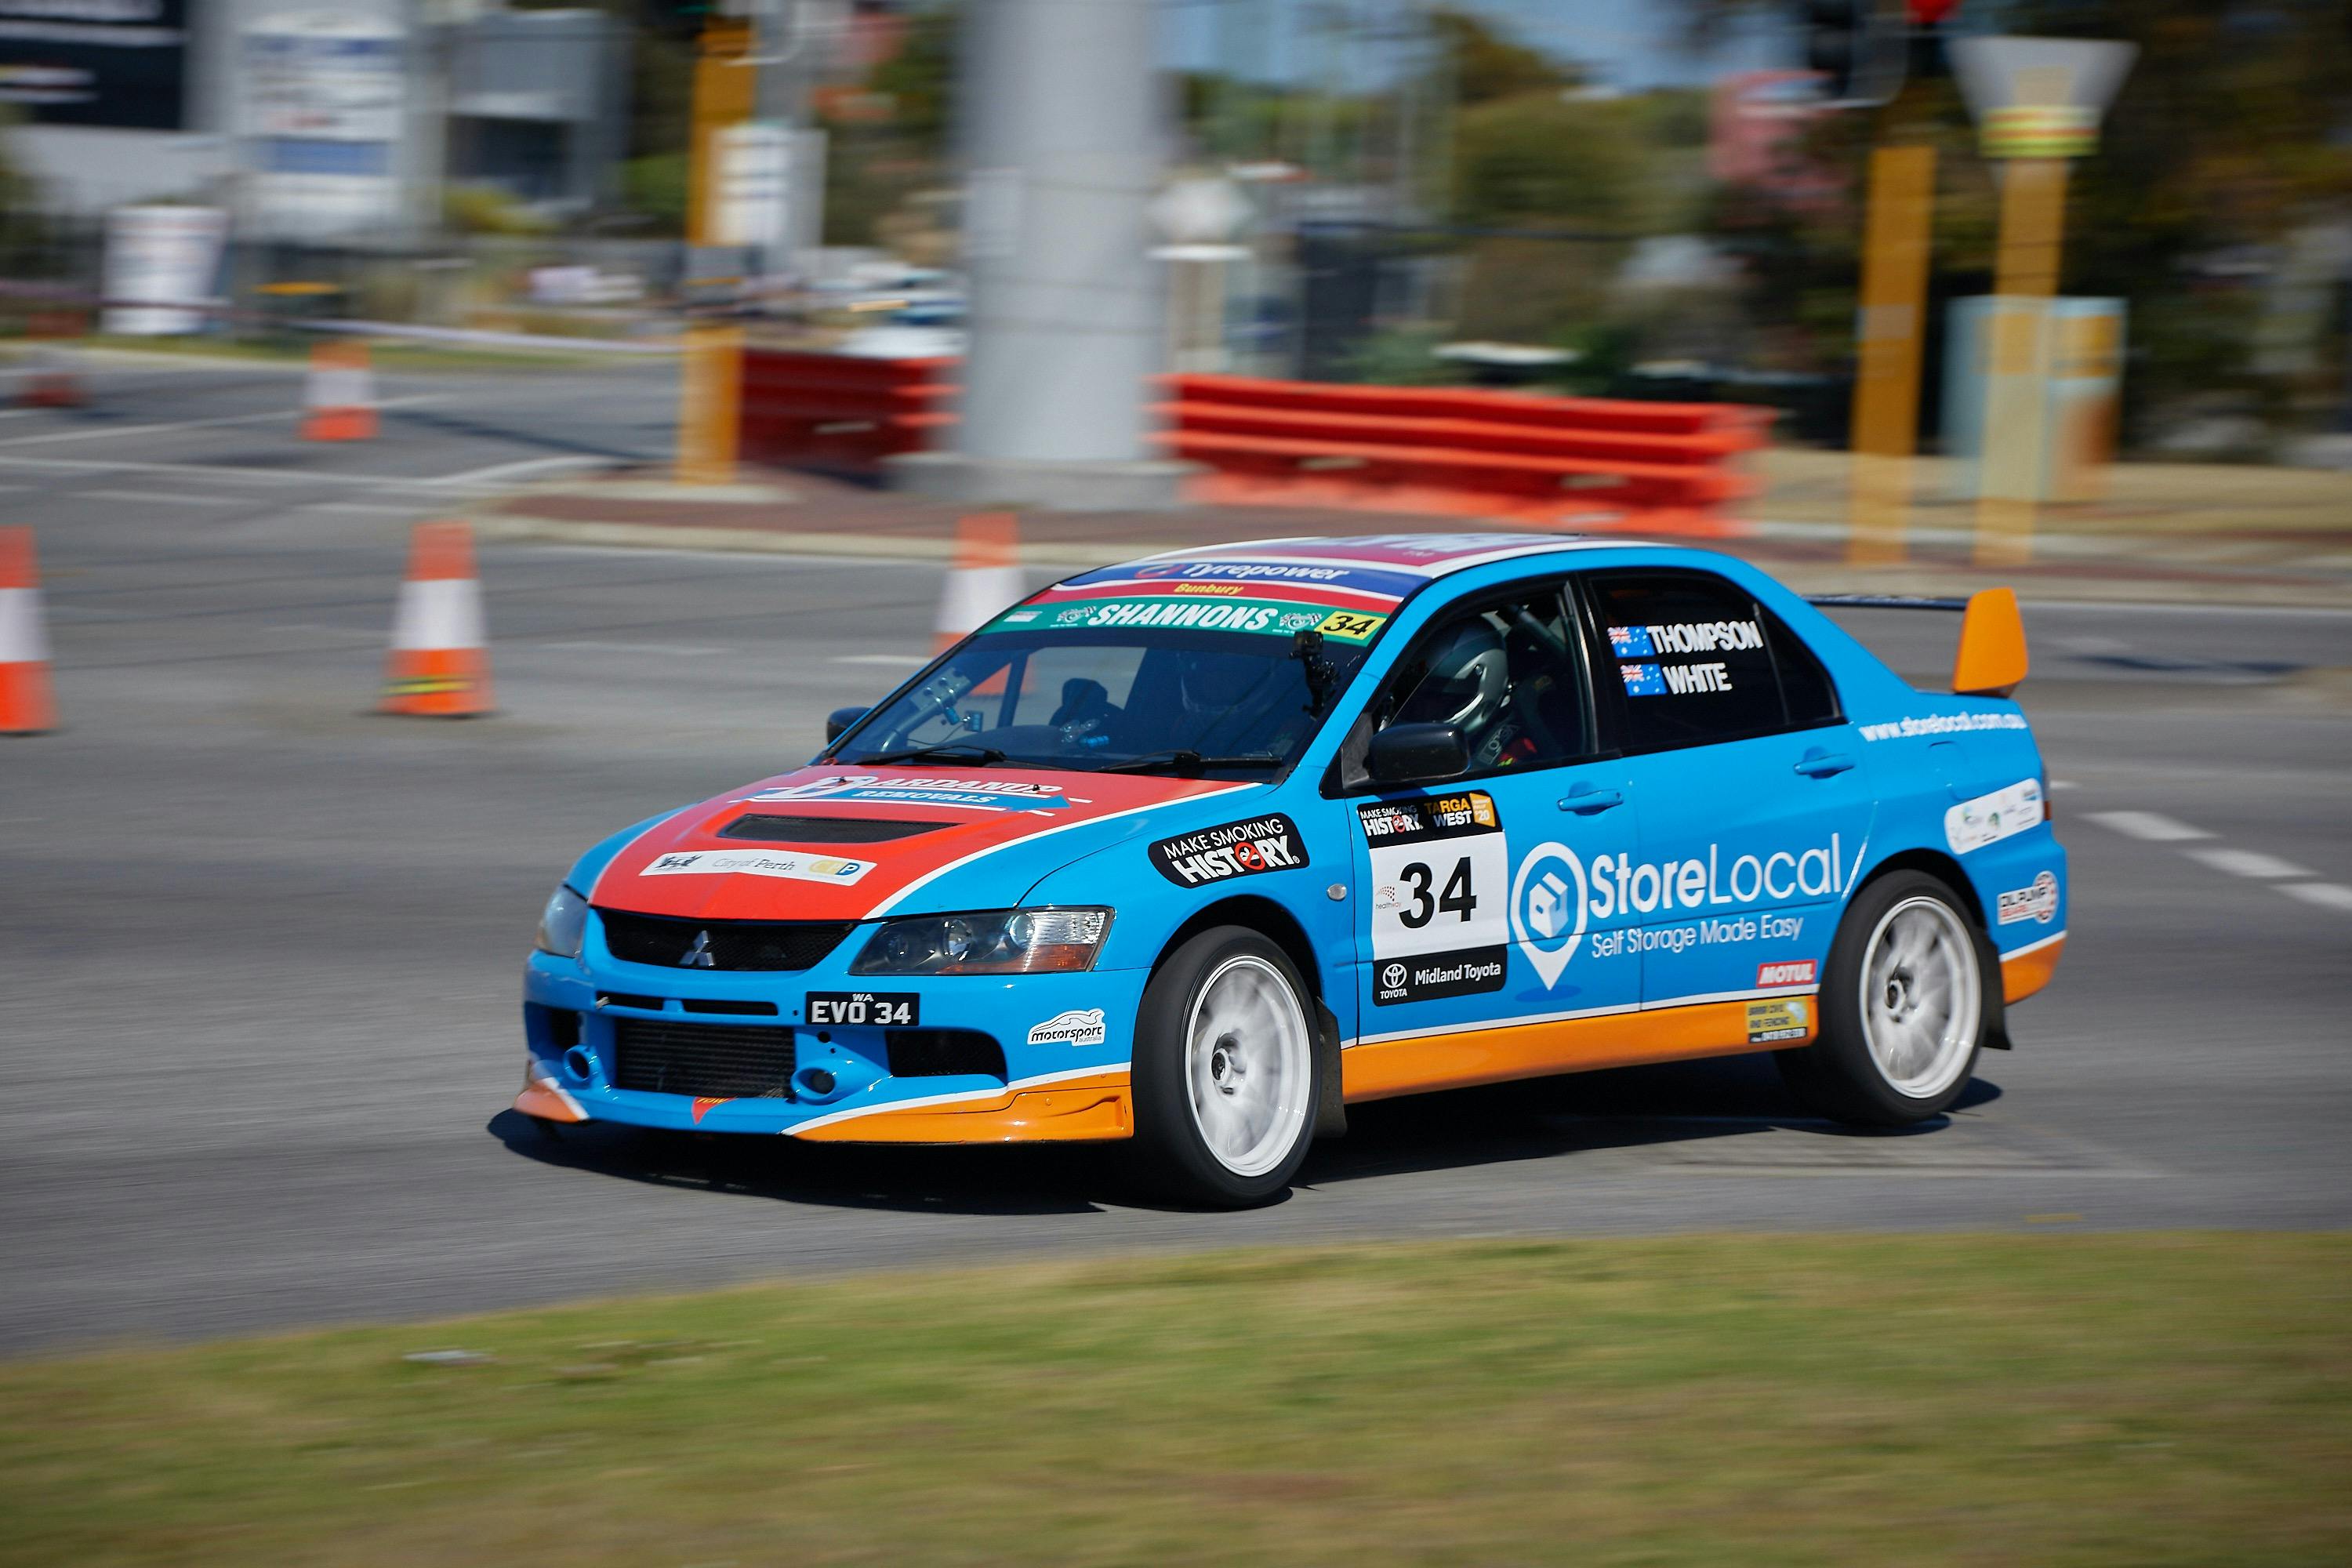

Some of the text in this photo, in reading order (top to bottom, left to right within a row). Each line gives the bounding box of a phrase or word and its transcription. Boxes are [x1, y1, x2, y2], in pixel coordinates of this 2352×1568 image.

[1182, 563, 1350, 580] Tyrepower
[1174, 583, 1244, 595] Bunbury
[1087, 604, 1279, 630] SHANNONS
[1323, 615, 1377, 636] 34
[1646, 621, 1763, 654] THOMPSON
[1662, 662, 1733, 695] WHITE
[1858, 711, 2027, 742] www.storelocal.com.au
[852, 789, 1000, 804] REMOVALS
[1424, 797, 1472, 815] TARGA
[1359, 809, 1381, 820] MAKE
[1433, 810, 1472, 828] WEST
[1163, 818, 1283, 859] MAKE SMOKING
[754, 858, 797, 871] Perth
[1589, 832, 1841, 919] StoreLocal
[1399, 856, 1477, 929] 34
[1592, 914, 1803, 958] Self Storage Made Easy
[1415, 962, 1501, 985] Midland Toyota
[1759, 963, 1813, 984] MOTUL
[852, 993, 874, 1002] WA
[1380, 988, 1408, 1000] TOYOTA
[811, 1000, 911, 1025] EVO 34
[1031, 1026, 1102, 1042] motorsport
[1079, 1035, 1102, 1044] australia
